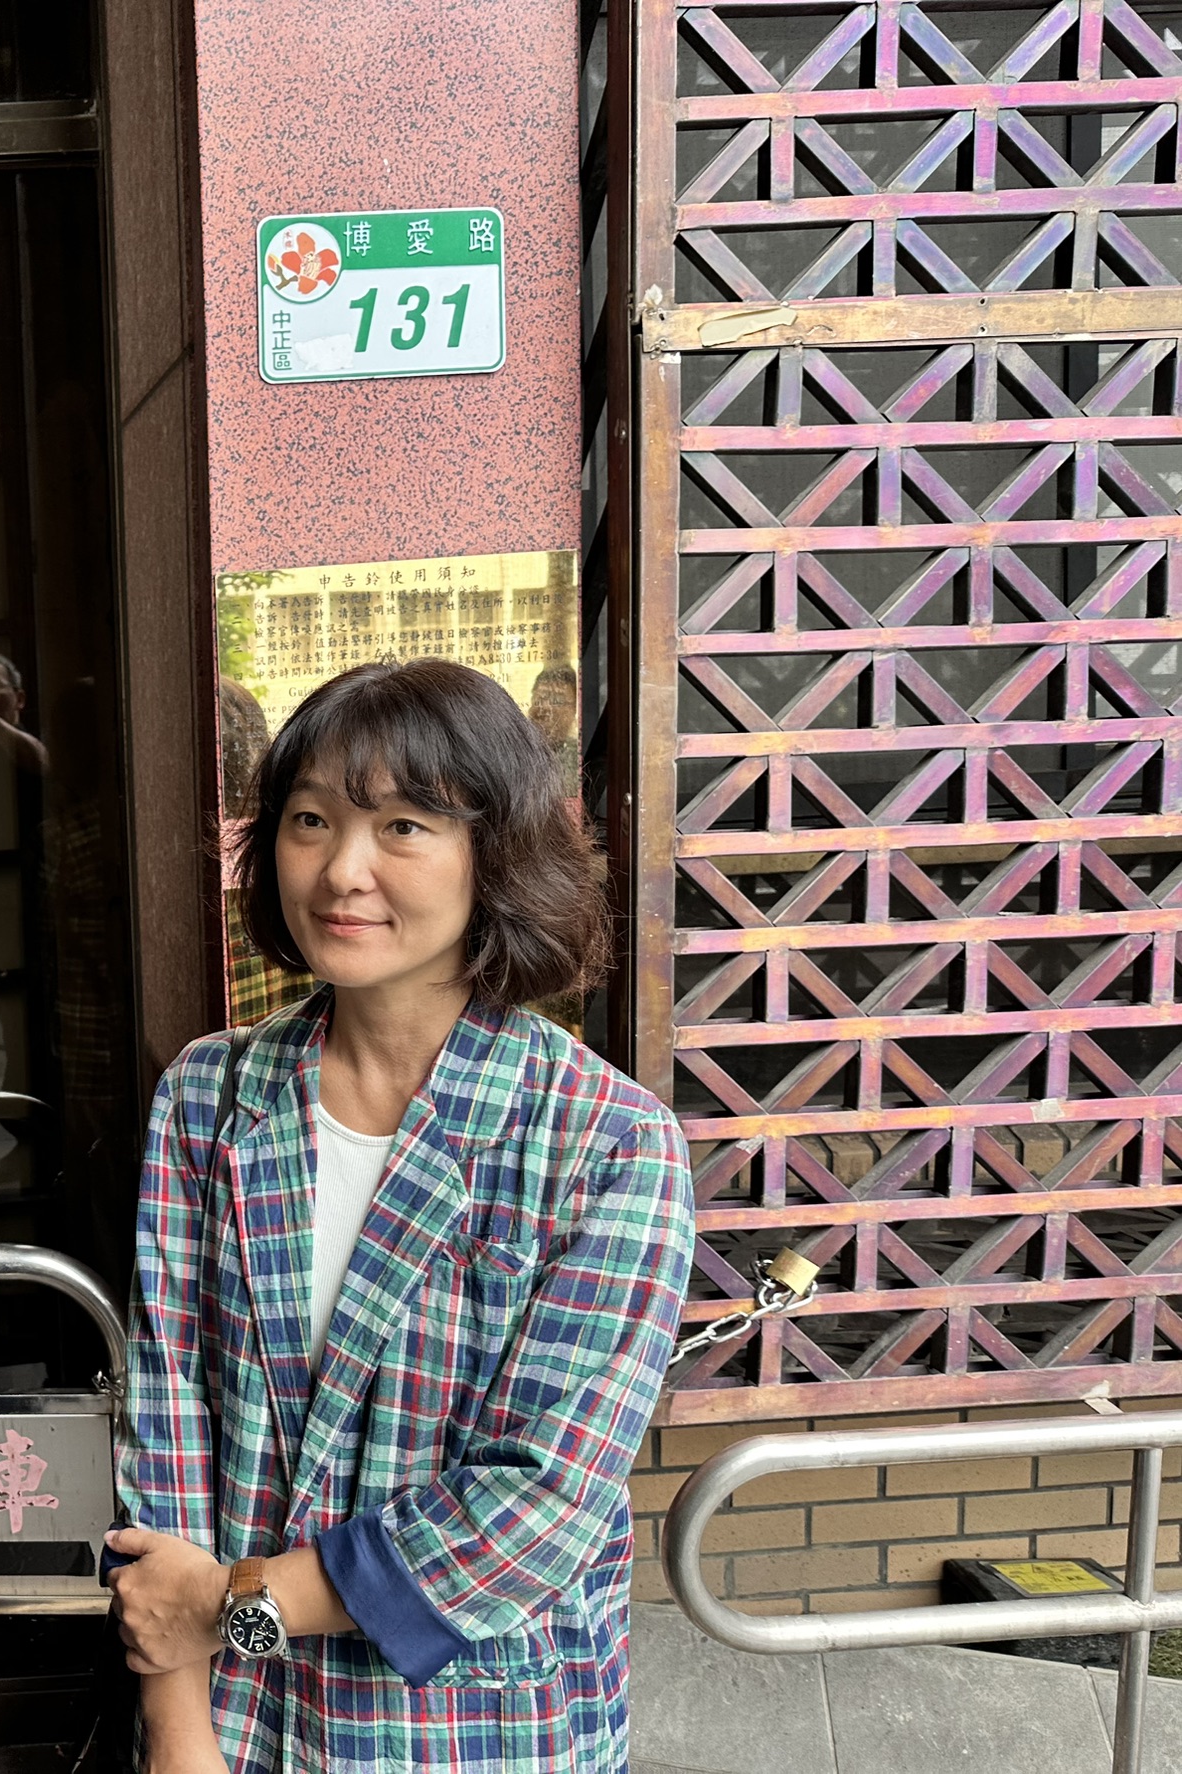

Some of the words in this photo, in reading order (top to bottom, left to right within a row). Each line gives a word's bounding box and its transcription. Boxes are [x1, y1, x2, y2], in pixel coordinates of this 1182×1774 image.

[343, 217, 495, 257] 博愛路
[271, 309, 293, 371] 中正區
[349, 283, 471, 353] 131
[318, 565, 477, 590] 申告鈴使用須知
